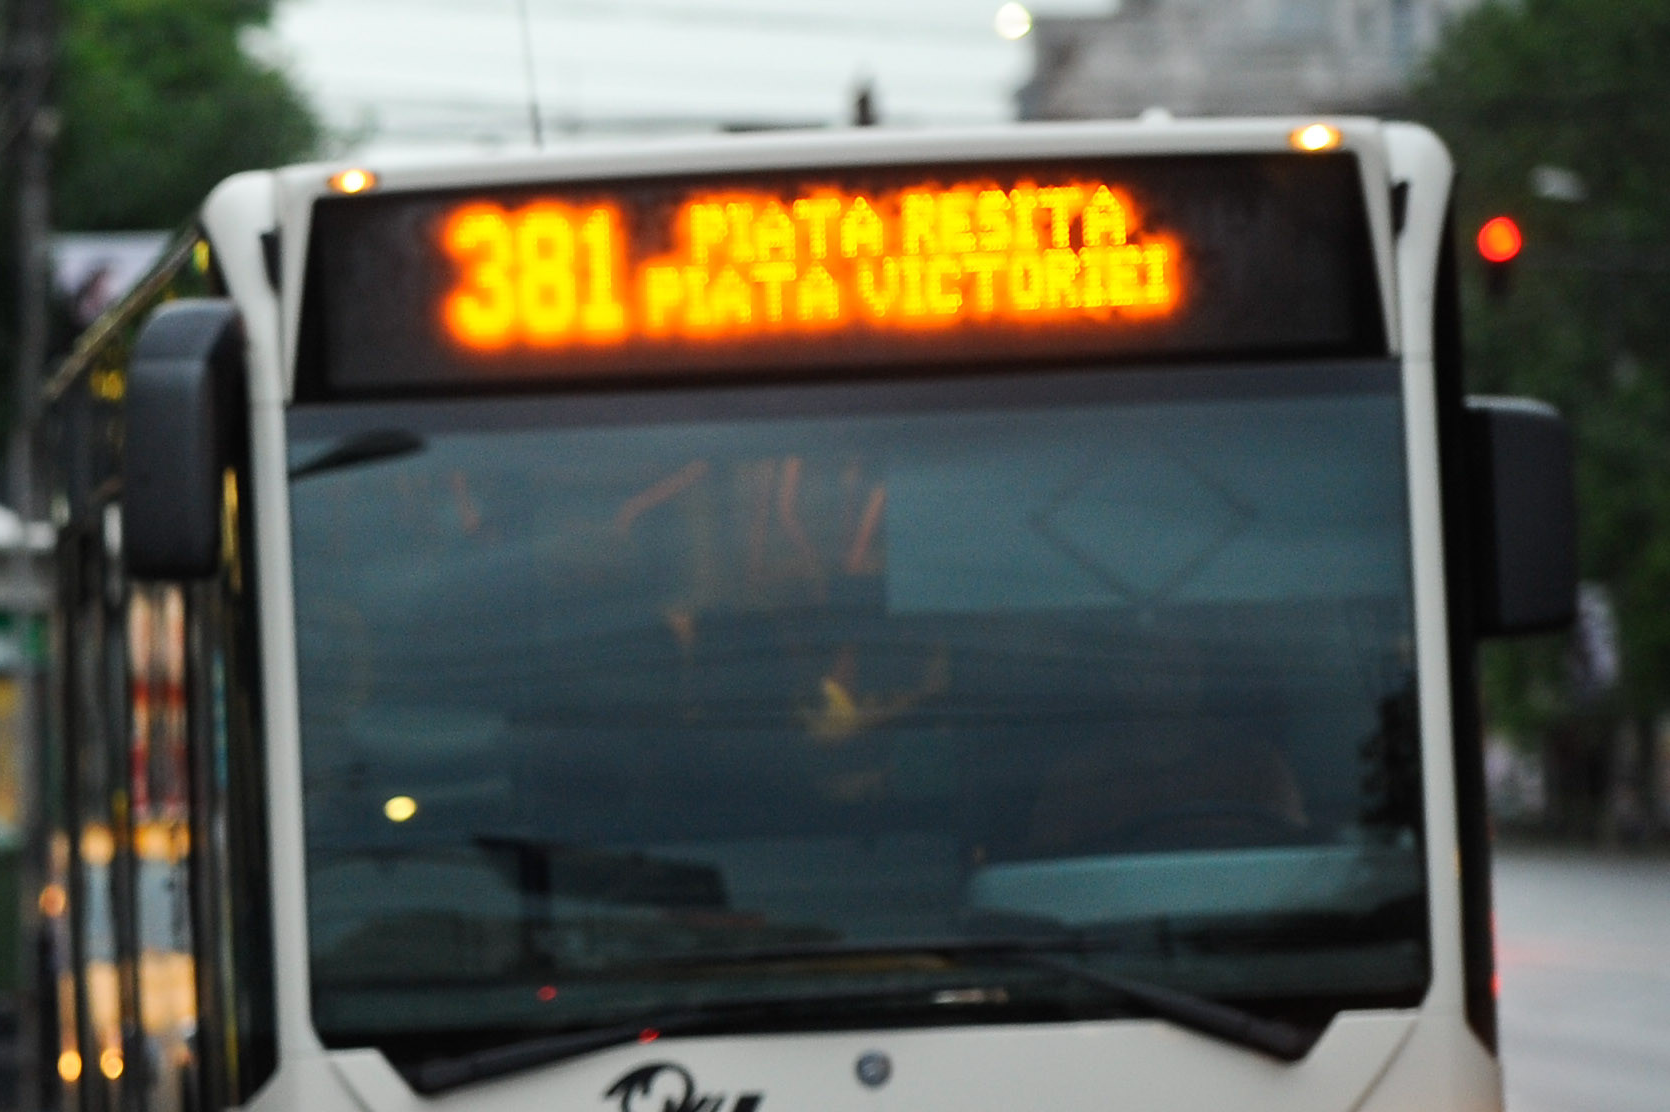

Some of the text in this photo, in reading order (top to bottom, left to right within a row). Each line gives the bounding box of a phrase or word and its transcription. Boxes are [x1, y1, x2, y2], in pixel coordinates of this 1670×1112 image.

[689, 184, 1128, 264] PIATA RESITA
[452, 206, 625, 338] 381
[644, 243, 1169, 328] PIATA VICTORIEI
